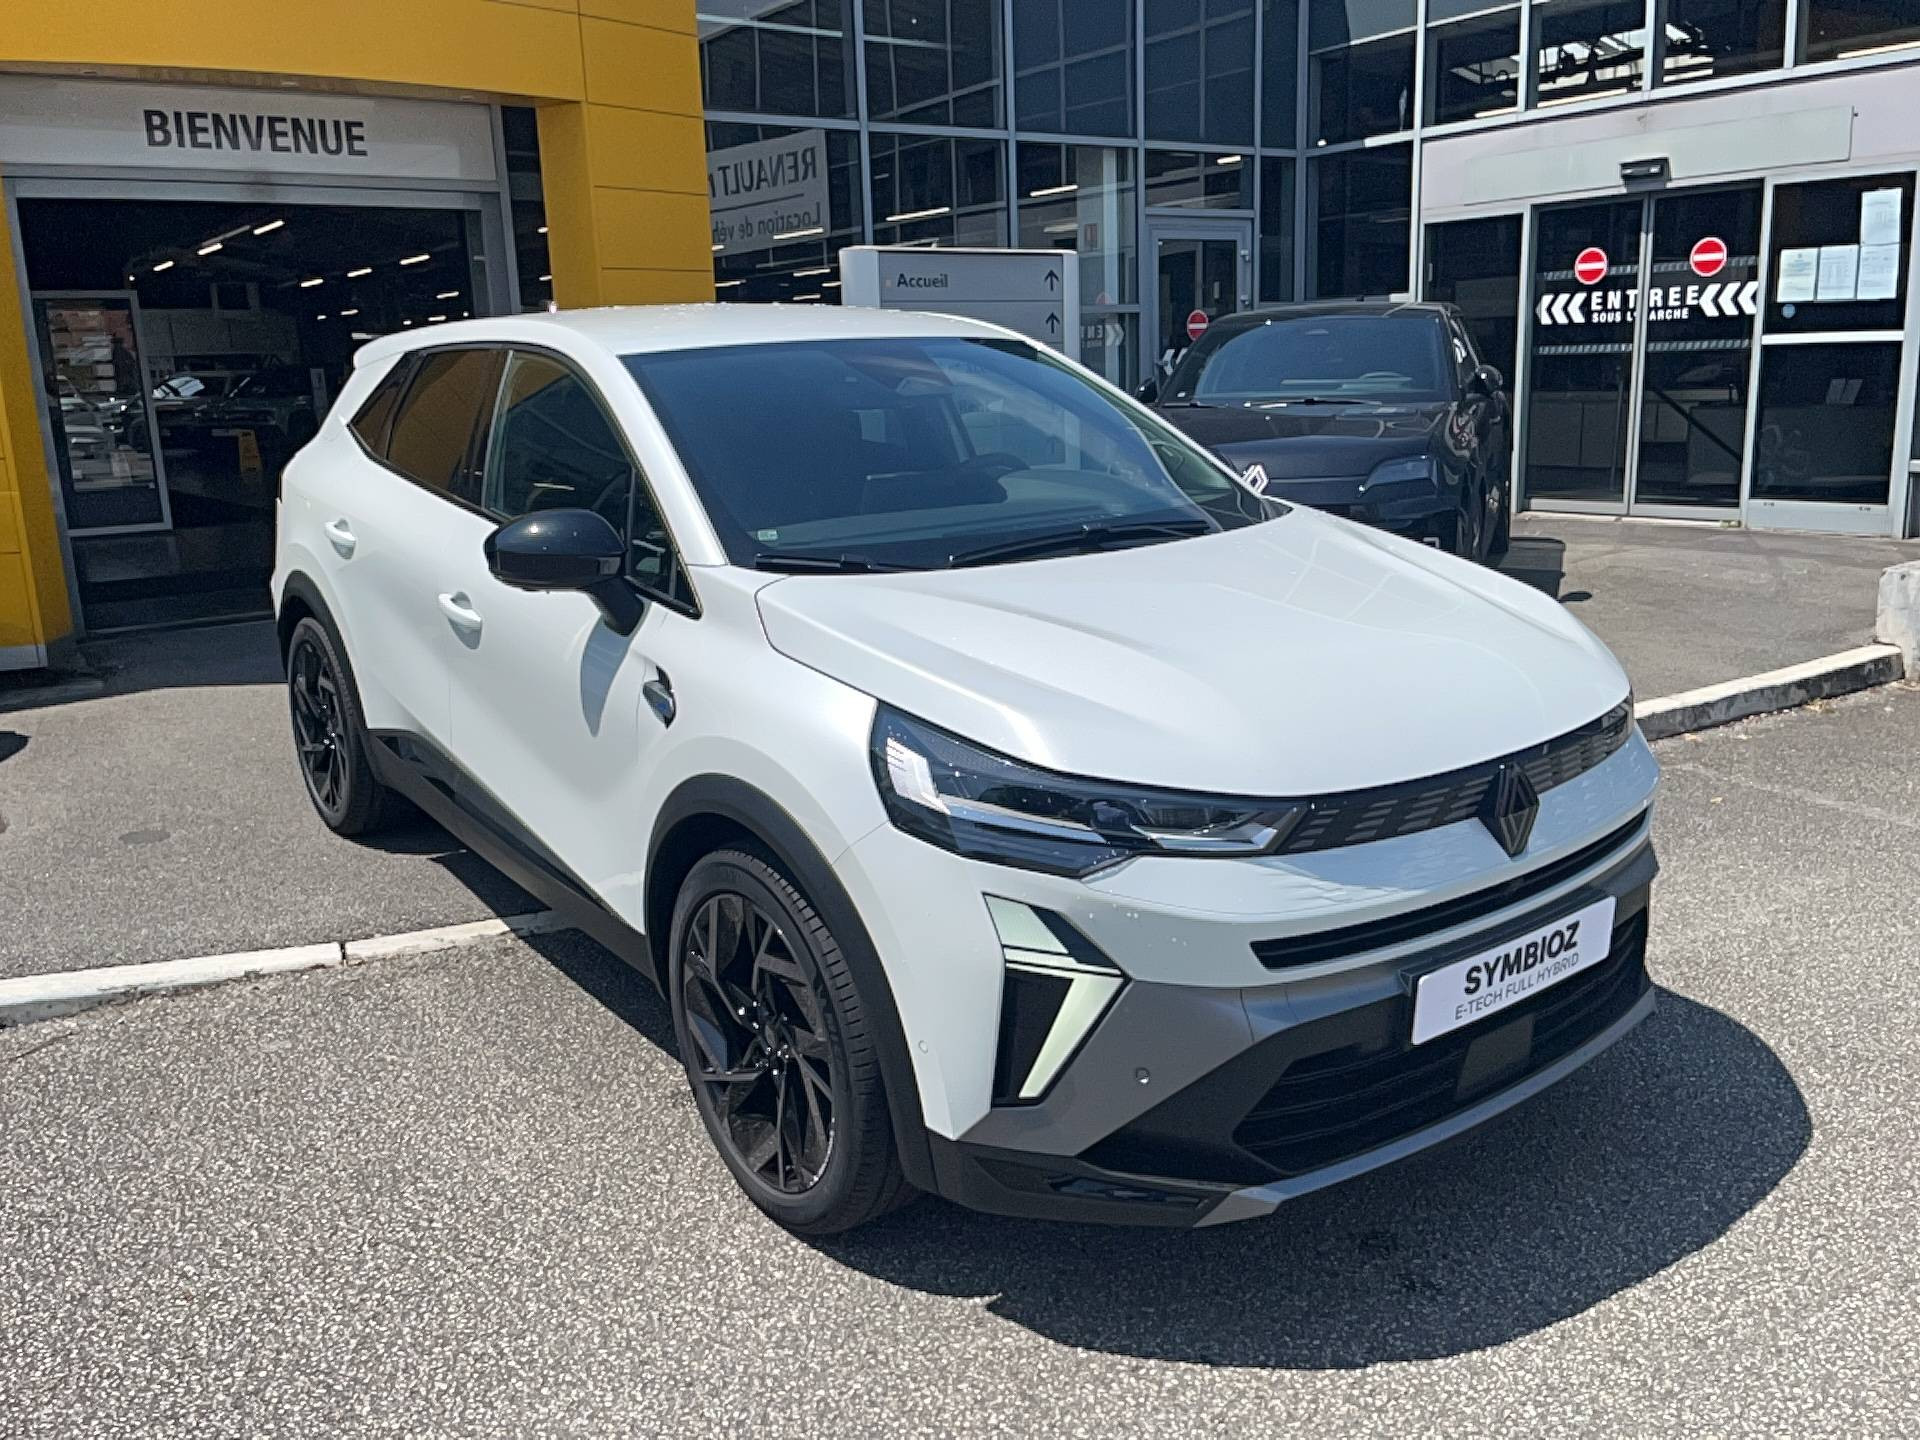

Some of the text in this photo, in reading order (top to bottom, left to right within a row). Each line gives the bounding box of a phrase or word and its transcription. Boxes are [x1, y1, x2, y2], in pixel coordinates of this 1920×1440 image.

[143, 109, 369, 157] BIENVENUE
[896, 273, 949, 289] Accueil
[1590, 285, 1700, 311] ENTREE
[1592, 311, 1622, 323] SOUS
[1464, 920, 1580, 995] SYMBIOZ
[1455, 952, 1580, 1020] E-TECH FULL HYBRID
